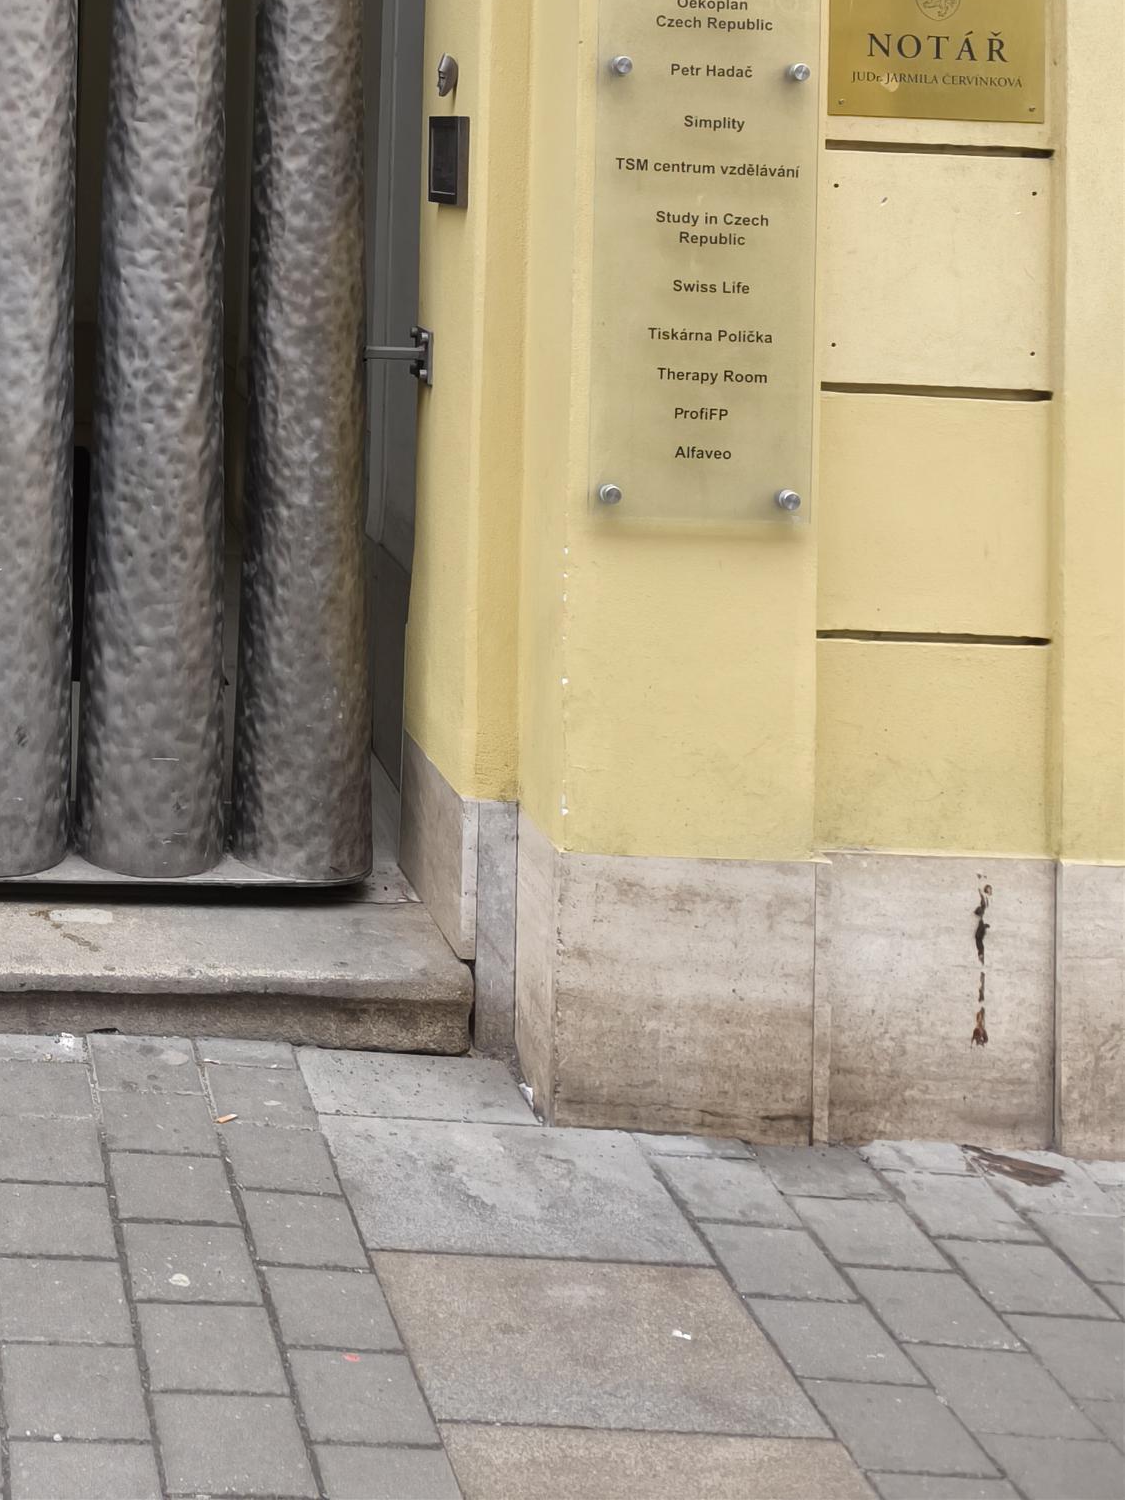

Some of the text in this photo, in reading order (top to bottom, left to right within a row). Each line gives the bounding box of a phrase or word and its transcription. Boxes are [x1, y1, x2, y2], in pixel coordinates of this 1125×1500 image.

[656, 15, 773, 32] Czech Republic
[867, 31, 1008, 62] NOTÁŘ
[671, 64, 752, 78] Petr Hadač
[851, 71, 883, 83] JUDr.
[885, 73, 938, 84] JARMILA
[684, 115, 745, 132] Simplity
[616, 158, 799, 178] TSM centrum vzdělávání
[656, 211, 768, 227] Study in Czech
[679, 231, 745, 247] Republic
[673, 280, 749, 294] Swiss Life
[648, 328, 772, 343] Tiskárna Polička
[657, 367, 767, 385] Therapy Room
[675, 408, 728, 420] ProfiFP
[675, 446, 731, 459] Alfaveo
